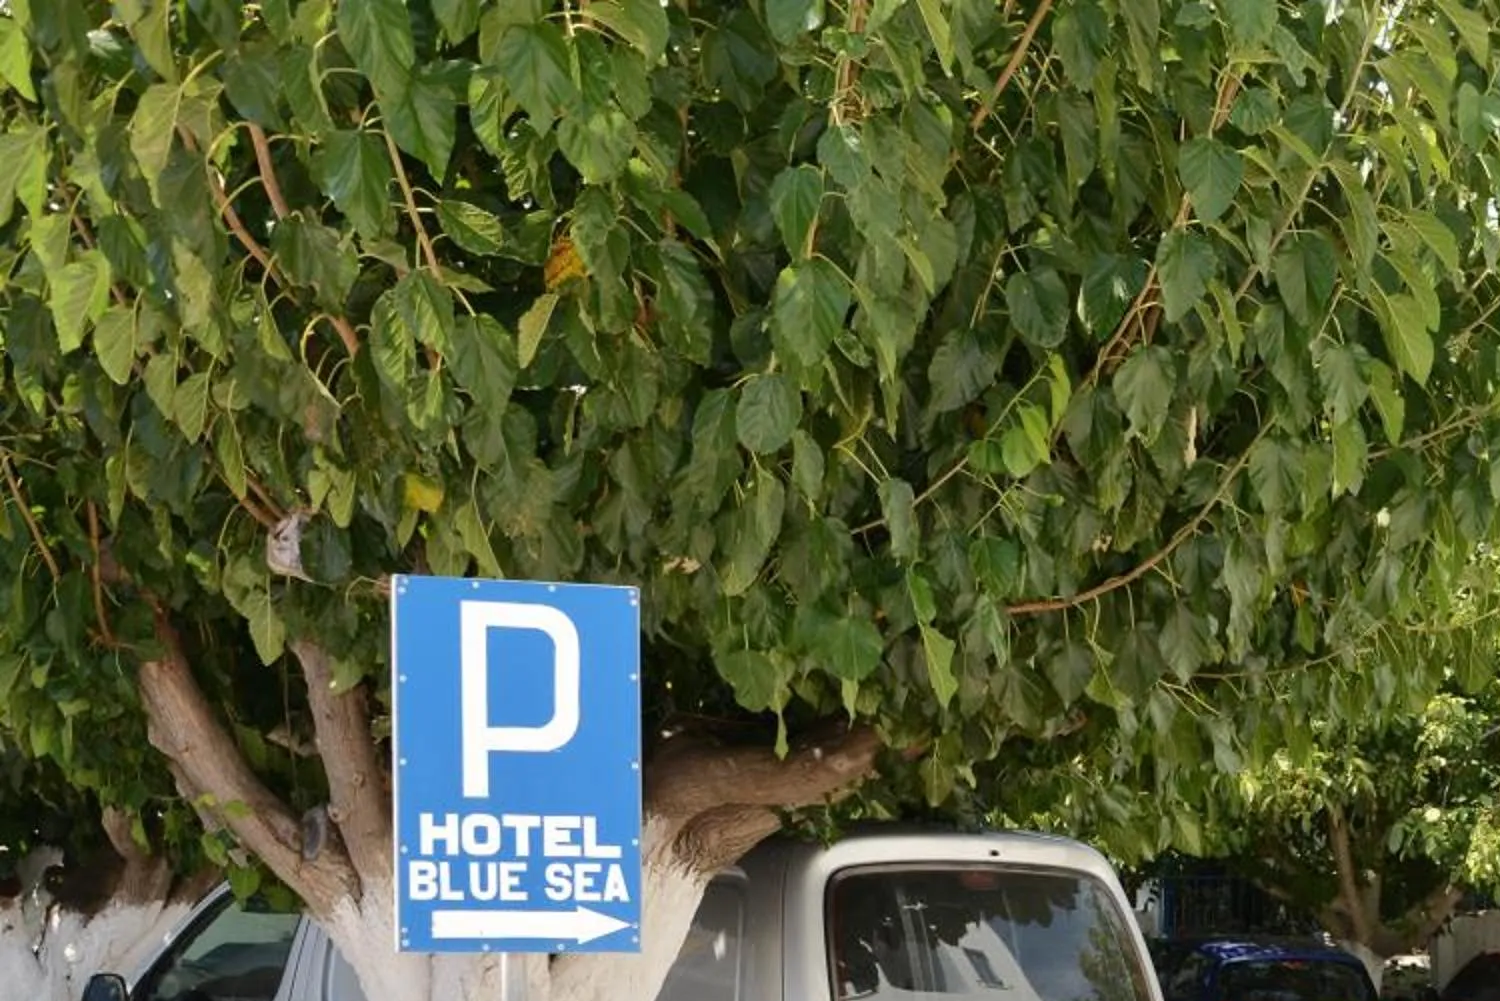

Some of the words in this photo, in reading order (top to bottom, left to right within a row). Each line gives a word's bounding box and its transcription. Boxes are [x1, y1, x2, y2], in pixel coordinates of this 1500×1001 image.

[459, 599, 581, 798] P
[419, 812, 622, 859] HOTEL
[408, 860, 528, 901] BLUE
[544, 862, 630, 902] SEA
